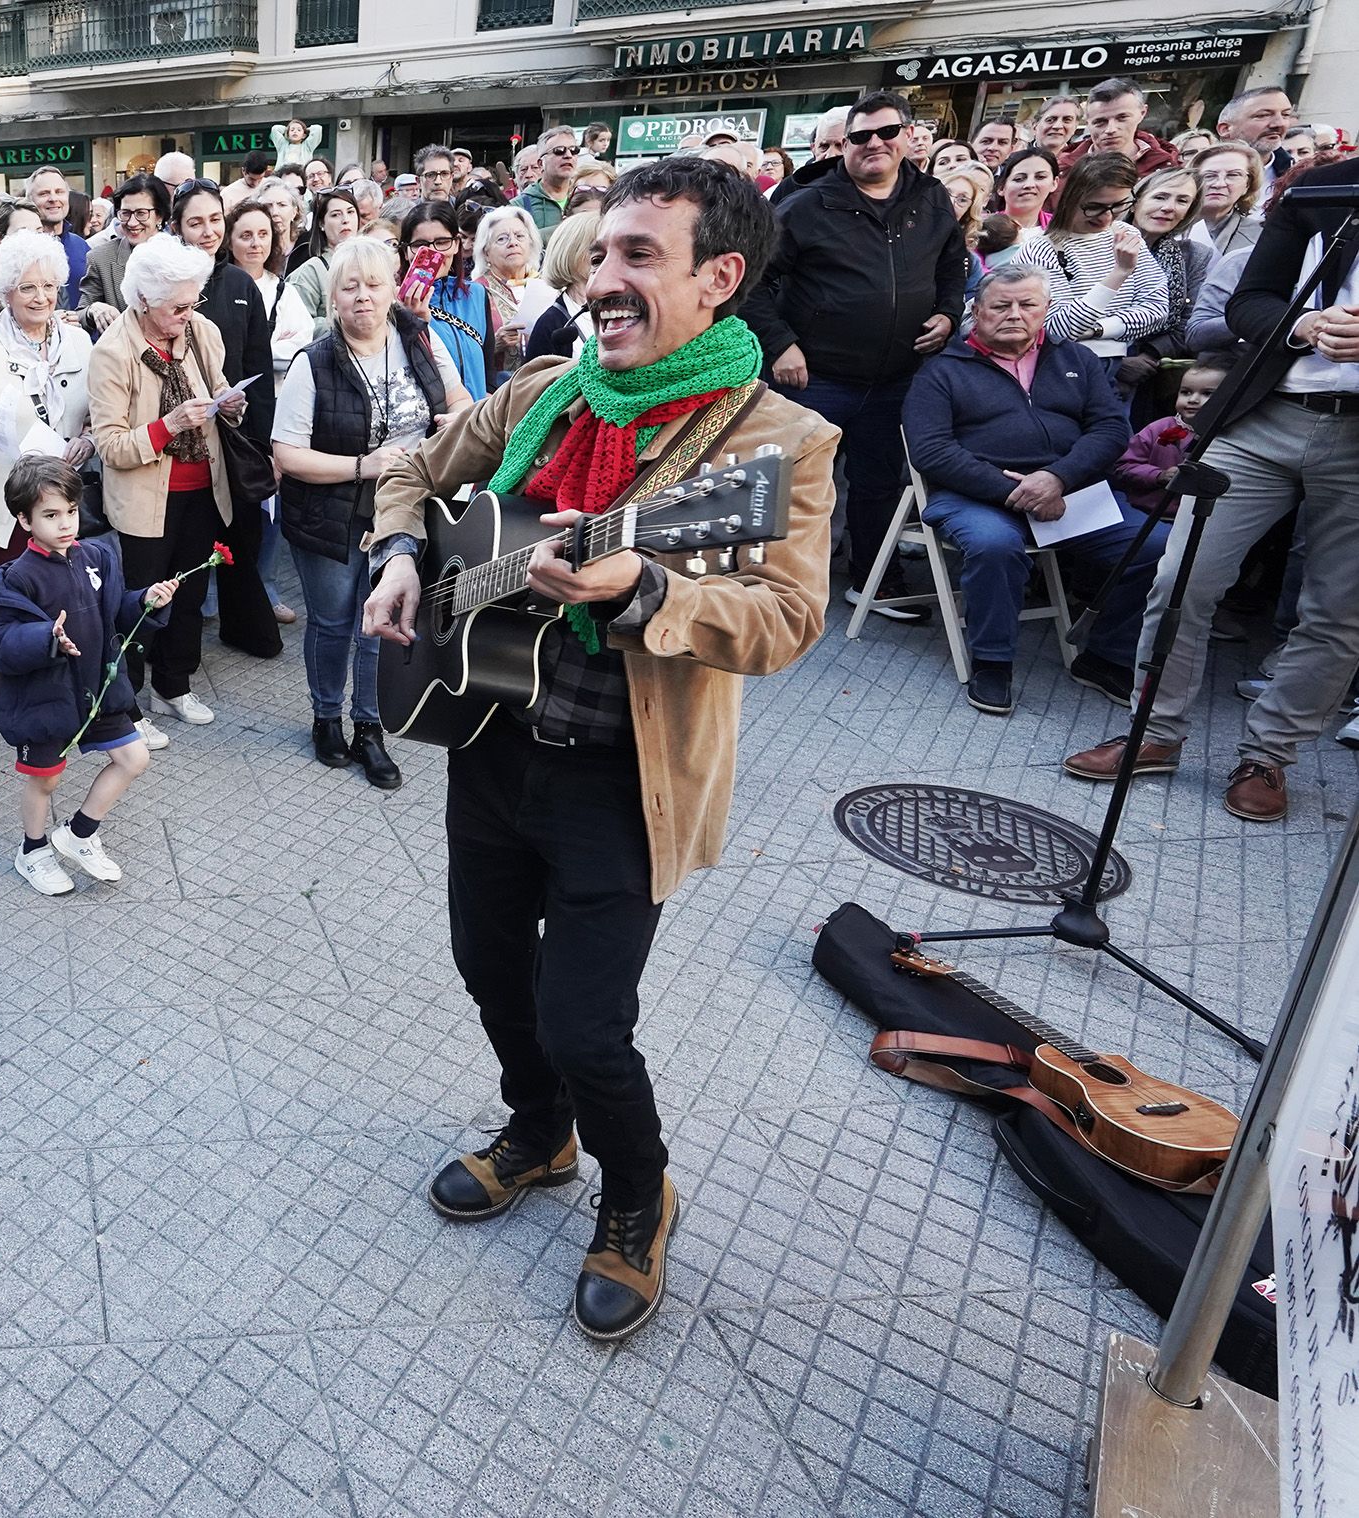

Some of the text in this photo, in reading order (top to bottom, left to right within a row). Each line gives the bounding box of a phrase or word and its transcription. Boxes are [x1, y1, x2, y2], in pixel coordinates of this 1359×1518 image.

[614, 26, 866, 68] INMOBILIARIA
[1123, 49, 1241, 66] regalo souvenirs
[1196, 37, 1243, 51] galega
[927, 46, 1108, 79] AGASALLO
[636, 70, 779, 98] PEDROSA
[645, 116, 751, 137] PEDROSA
[752, 470, 771, 527] Admira
[1307, 1322, 1320, 1376] DE
